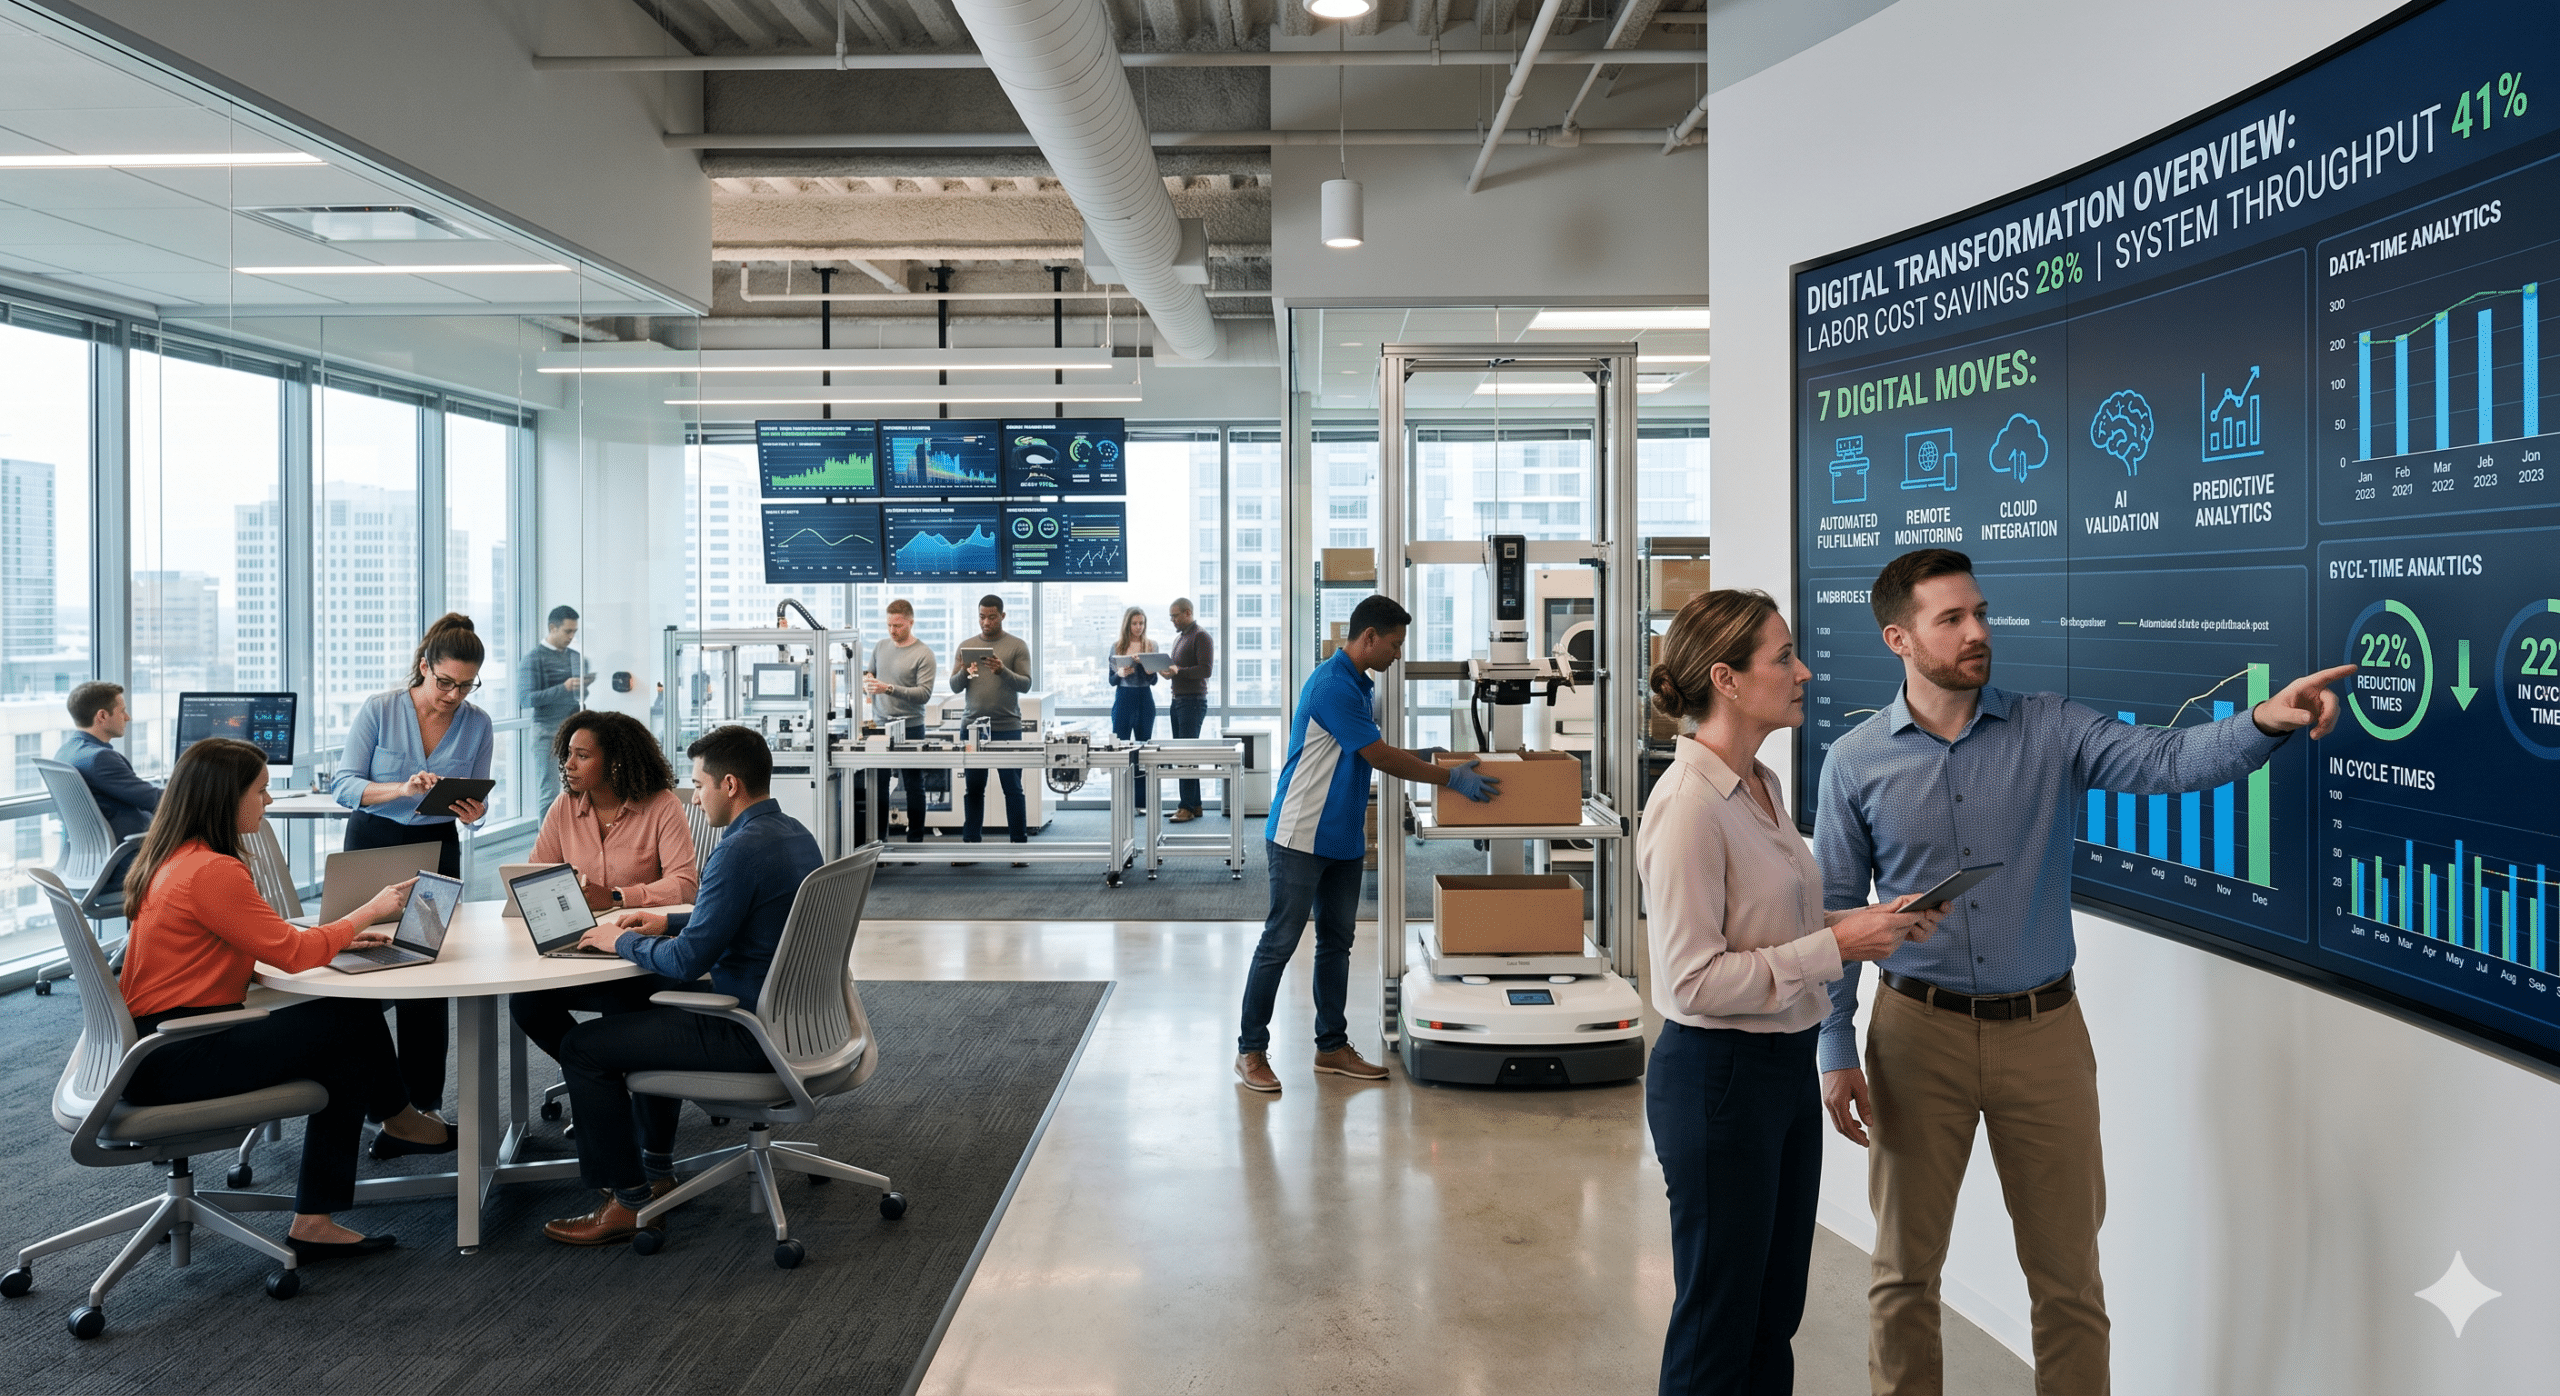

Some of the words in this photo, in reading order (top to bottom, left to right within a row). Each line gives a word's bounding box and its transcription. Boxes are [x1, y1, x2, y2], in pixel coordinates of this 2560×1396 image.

[1807, 265, 1889, 315] DIGITAL
[1894, 180, 2125, 290] TRANSFORMATION
[2133, 109, 2296, 211] OVERVIEW:
[1808, 313, 1868, 352] LABOR
[1874, 296, 1929, 336] COST
[1933, 267, 2029, 322] SAVINGS
[2035, 251, 2083, 295] 28%
[2115, 198, 2219, 269] SYSTEM
[2226, 103, 2441, 230] THROUGHPUT
[2450, 71, 2528, 139] 41%
[2329, 232, 2407, 277] DATA-TIME
[2410, 199, 2501, 251] ANALYTICS
[2329, 298, 2346, 313] 300
[2329, 338, 2346, 351] 200
[1817, 390, 1832, 422] 7
[1837, 371, 1929, 419] DIGITAL
[1935, 348, 2037, 403] MOVES:
[2330, 378, 2346, 391] 100
[2334, 418, 2346, 431] 50
[2340, 457, 2346, 468] 0
[2433, 461, 2451, 474] Mar
[2357, 471, 2373, 483] Jan
[2395, 465, 2411, 479] Feb
[2518, 468, 2545, 484] 2023
[2193, 473, 2275, 501] PREDICTIVE
[2431, 479, 2455, 492] 2022
[2473, 473, 2498, 488] 2023
[2114, 490, 2127, 509] AI
[2355, 487, 2376, 501] 2023
[1906, 506, 1951, 525] REMOTE
[1999, 499, 2038, 518] CLOUD
[2195, 501, 2272, 527] ANALYTICS
[1820, 513, 1878, 531] AUTOMATED
[2085, 511, 2159, 534] VALIDATION
[1894, 526, 1963, 546] MONITORING
[1981, 520, 2058, 541] INTEGRATION
[1817, 531, 1880, 549] FULFILLMENT
[2360, 633, 2411, 670] 22%
[2520, 637, 2560, 676] 22
[2357, 674, 2416, 693] REDUCTION
[2518, 683, 2531, 700] IN
[2371, 695, 2402, 712] TIMES
[2329, 756, 2343, 776] IN
[2346, 759, 2388, 783] CYCLE
[2391, 765, 2435, 791] TIMES
[2329, 789, 2343, 801] 100
[2216, 883, 2232, 896] Nov
[2252, 892, 2268, 906] Dec
[2351, 924, 2365, 937] Jan
[2374, 930, 2390, 943] Feb
[2397, 936, 2413, 950] Mar
[2422, 944, 2437, 958] Apr
[2475, 961, 2488, 974] Jul
